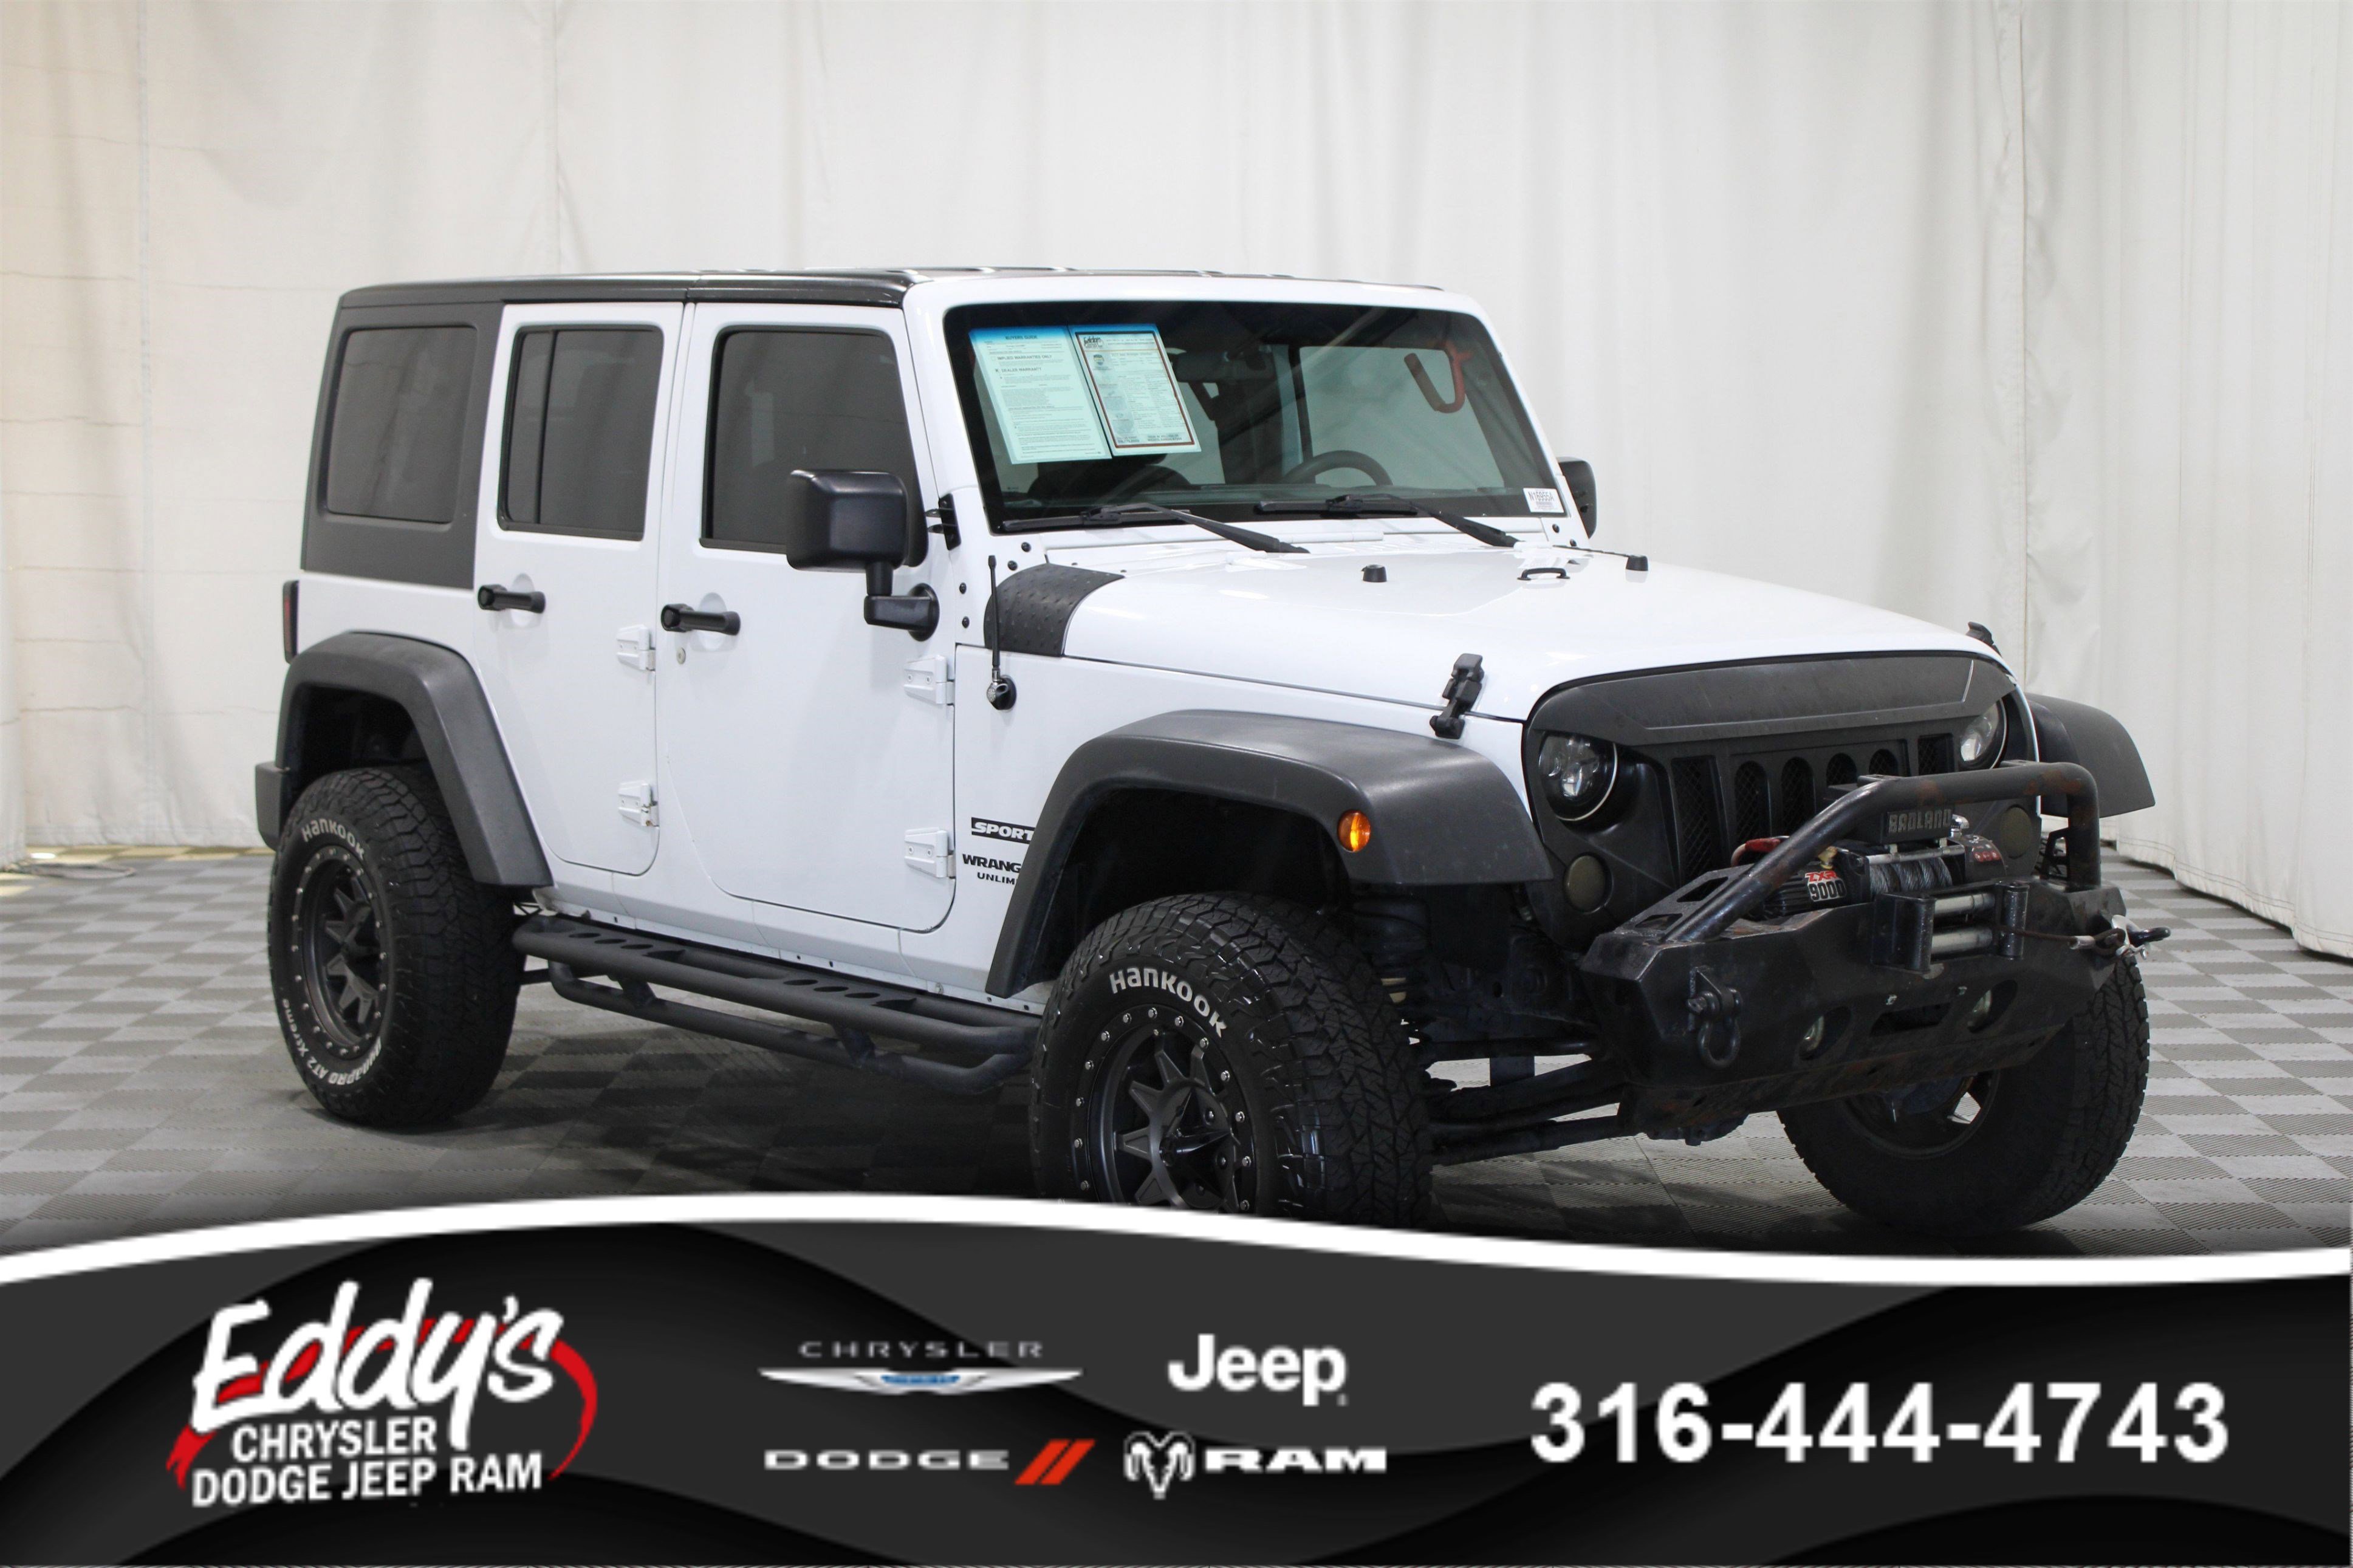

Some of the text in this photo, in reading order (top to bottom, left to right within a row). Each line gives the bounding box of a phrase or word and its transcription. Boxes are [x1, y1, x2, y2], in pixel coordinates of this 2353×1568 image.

[971, 821, 1035, 841] SPORT
[1805, 870, 1838, 883] ZXR
[1808, 879, 1846, 900] 9000
